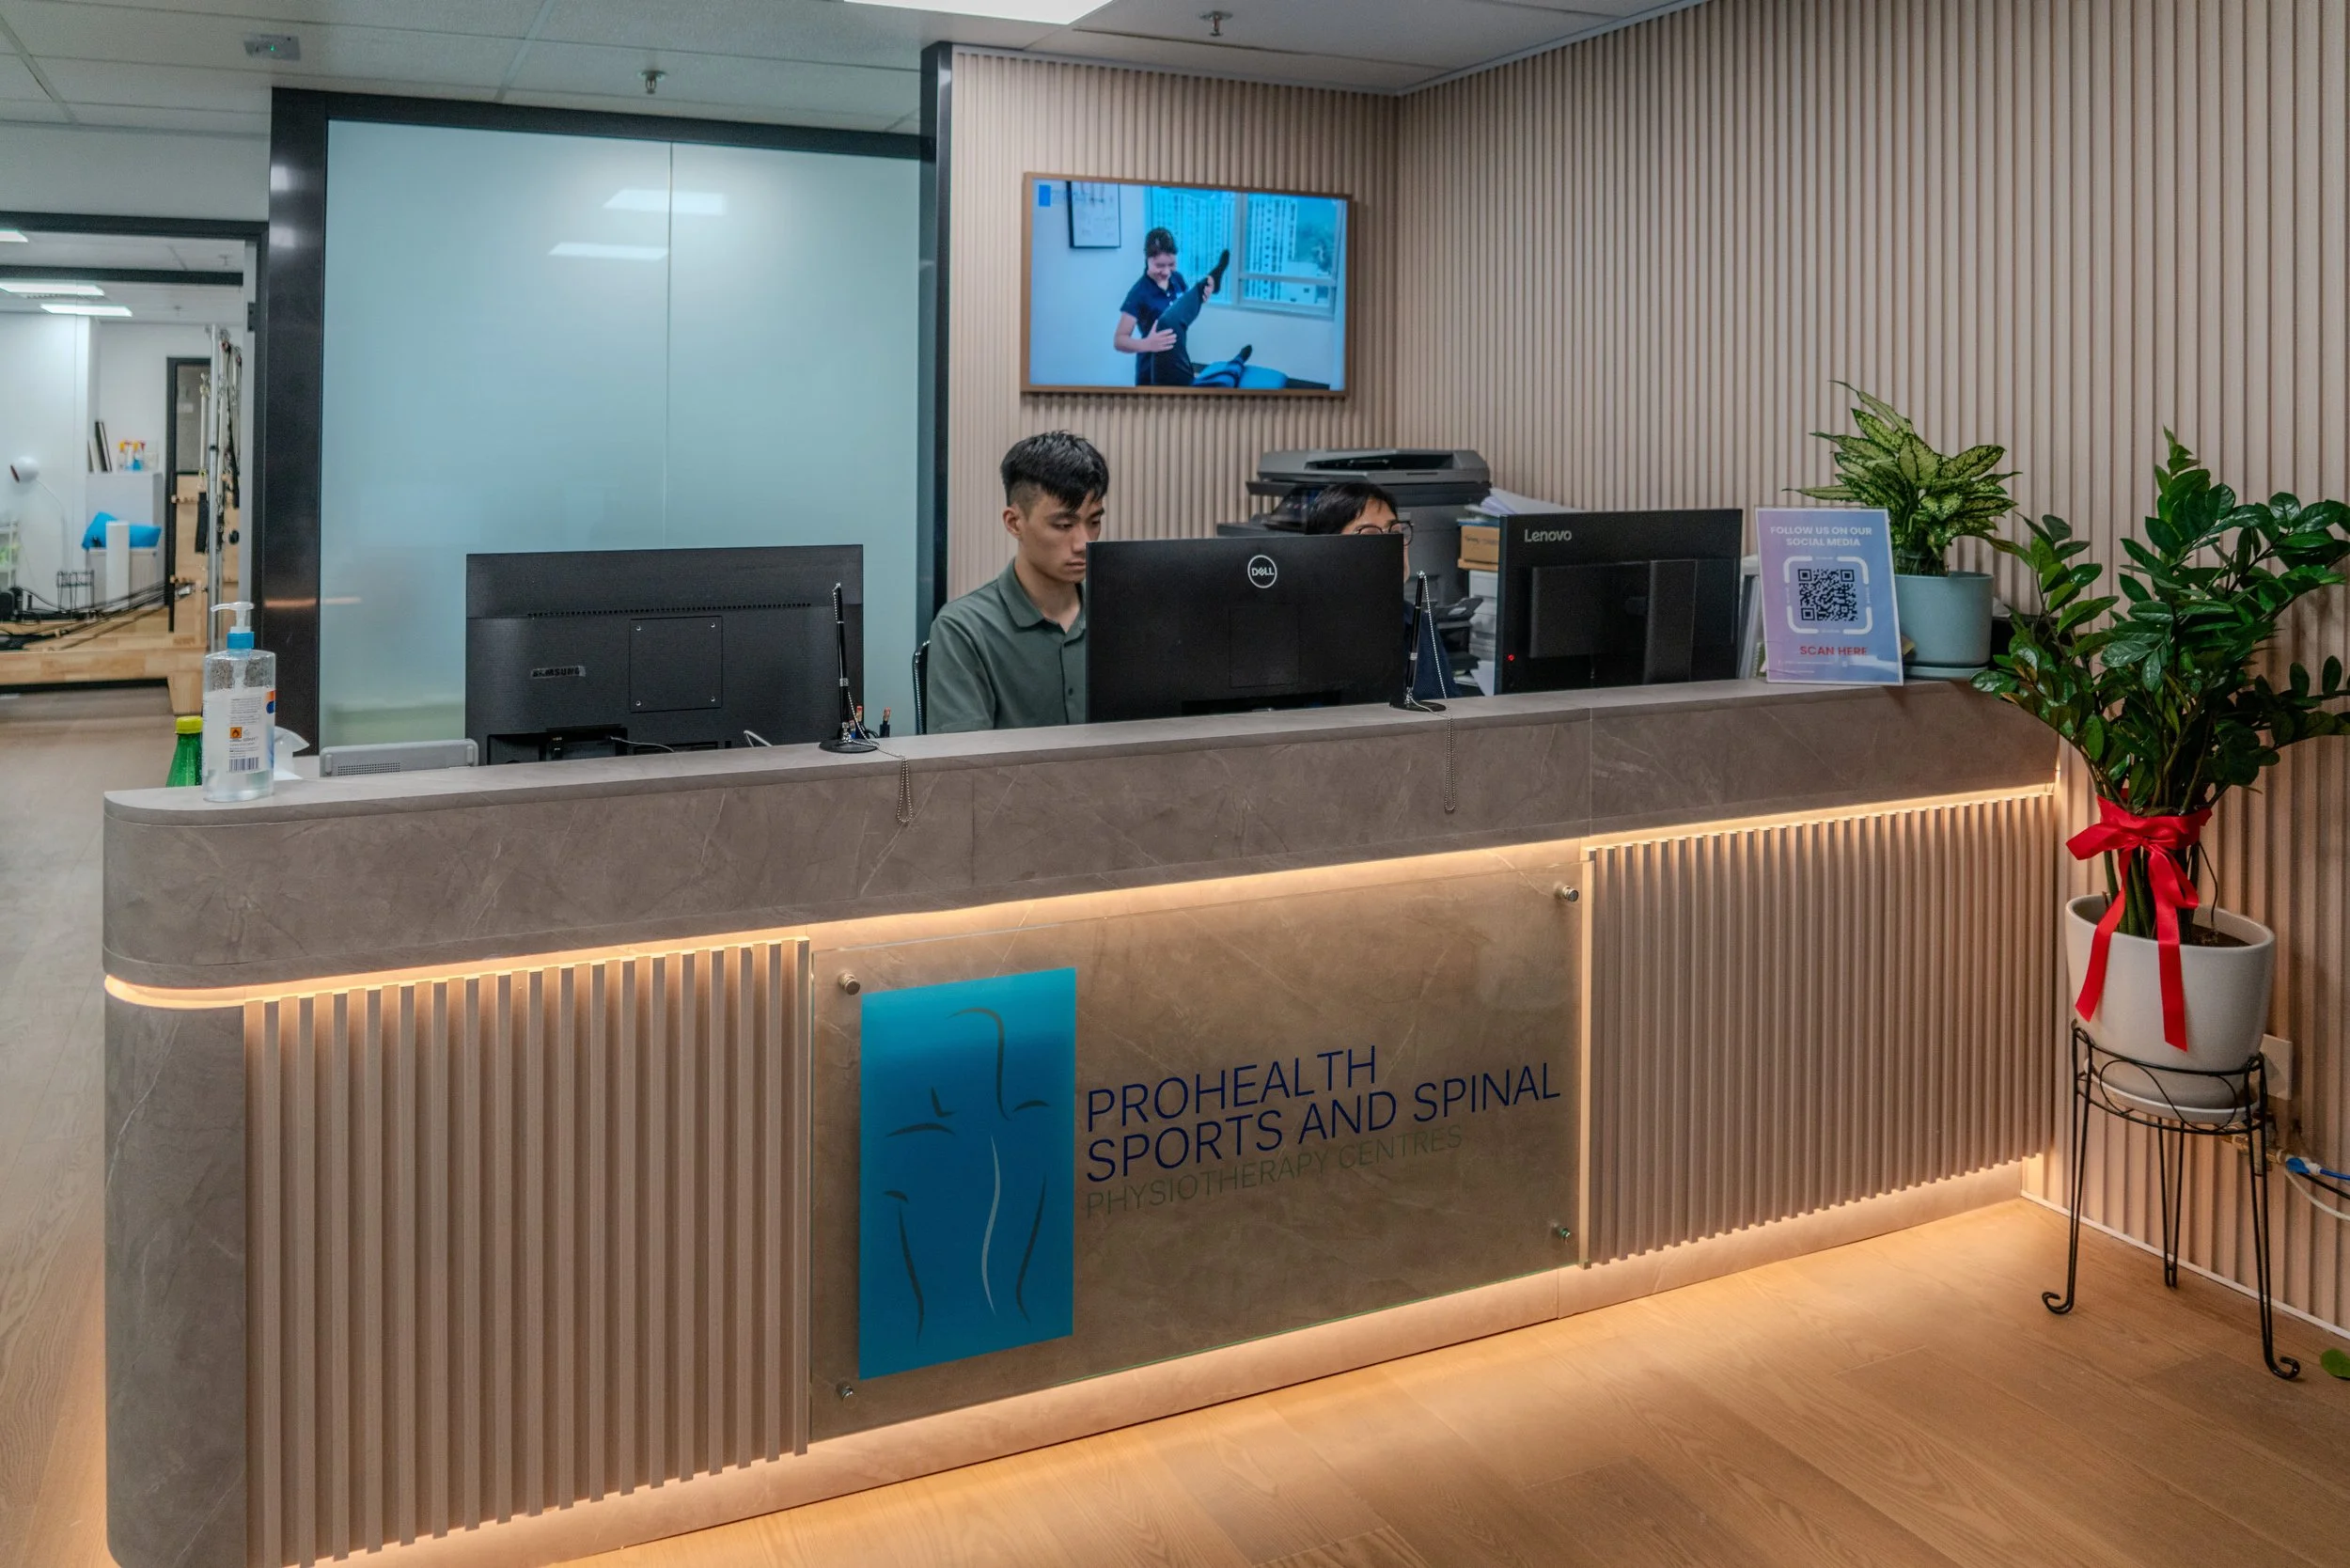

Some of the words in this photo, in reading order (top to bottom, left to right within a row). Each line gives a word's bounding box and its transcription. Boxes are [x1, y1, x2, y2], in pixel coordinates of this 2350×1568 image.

[1524, 528, 1573, 542] Lenovo
[1770, 526, 1813, 535] FOLLOW
[1815, 526, 1829, 535] US
[1831, 526, 1848, 535] ON
[1850, 526, 1872, 536] OUR
[1786, 538, 1825, 546] SOCIAL
[1826, 538, 1861, 546] MEDIA
[1251, 567, 1275, 576] DELL
[1800, 646, 1834, 656] SCAN
[1838, 646, 1868, 656] HERE
[1087, 1045, 1376, 1133] PROHEALTH
[1086, 1109, 1284, 1183] SPORTS
[1298, 1090, 1398, 1144] AND
[1413, 1062, 1561, 1122] SPINAL
[1087, 1151, 1328, 1219] PHYSIOTHERAPY
[1339, 1124, 1463, 1168] CENTRES
